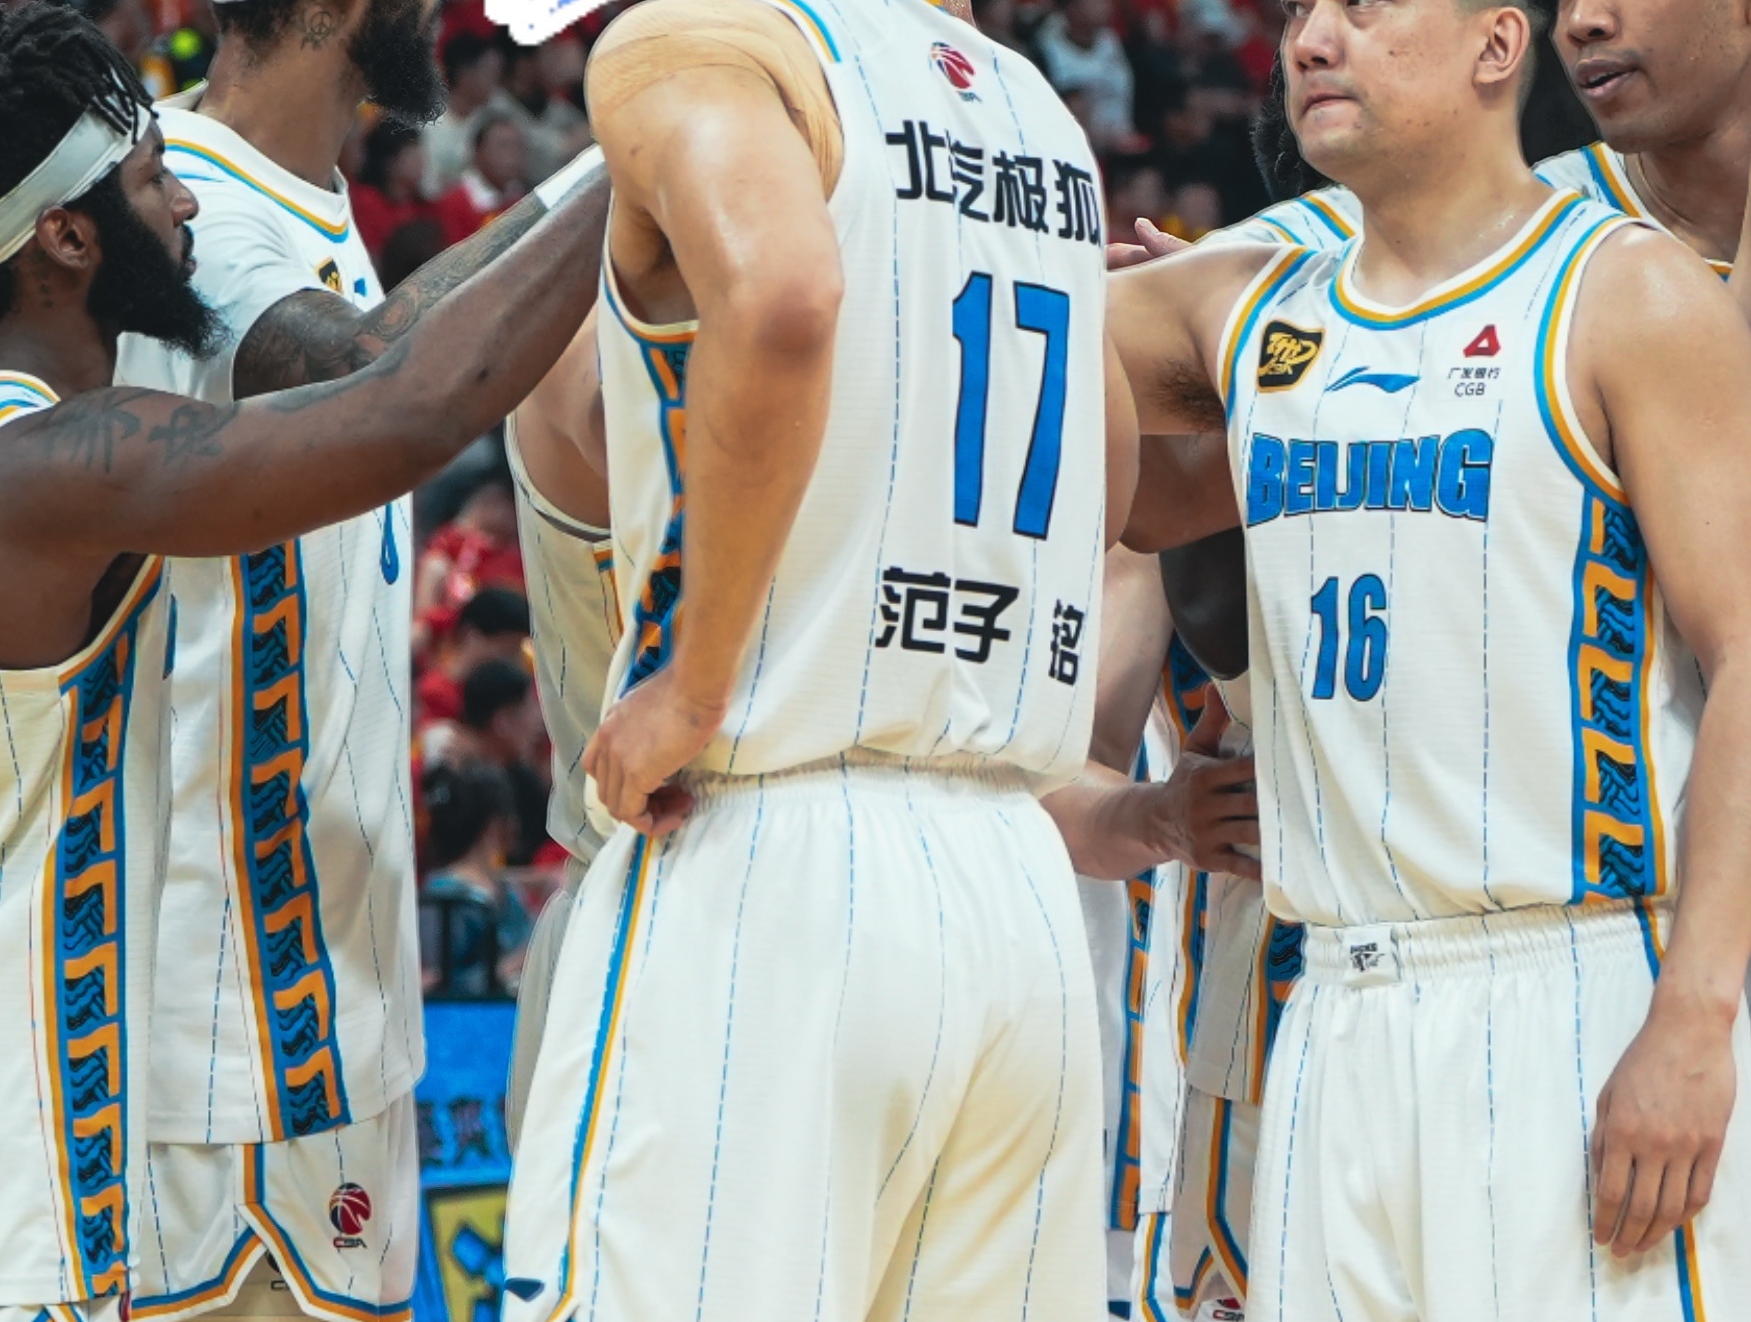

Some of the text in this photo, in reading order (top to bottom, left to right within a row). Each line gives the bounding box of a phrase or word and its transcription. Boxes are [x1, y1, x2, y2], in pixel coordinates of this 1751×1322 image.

[885, 120, 1102, 249] 北汽极狐
[951, 271, 1071, 541] 17
[1454, 382, 1486, 398] CGB
[1246, 427, 1495, 529] BEIJING
[875, 565, 1086, 687] 范子铭
[1310, 572, 1390, 703] 16
